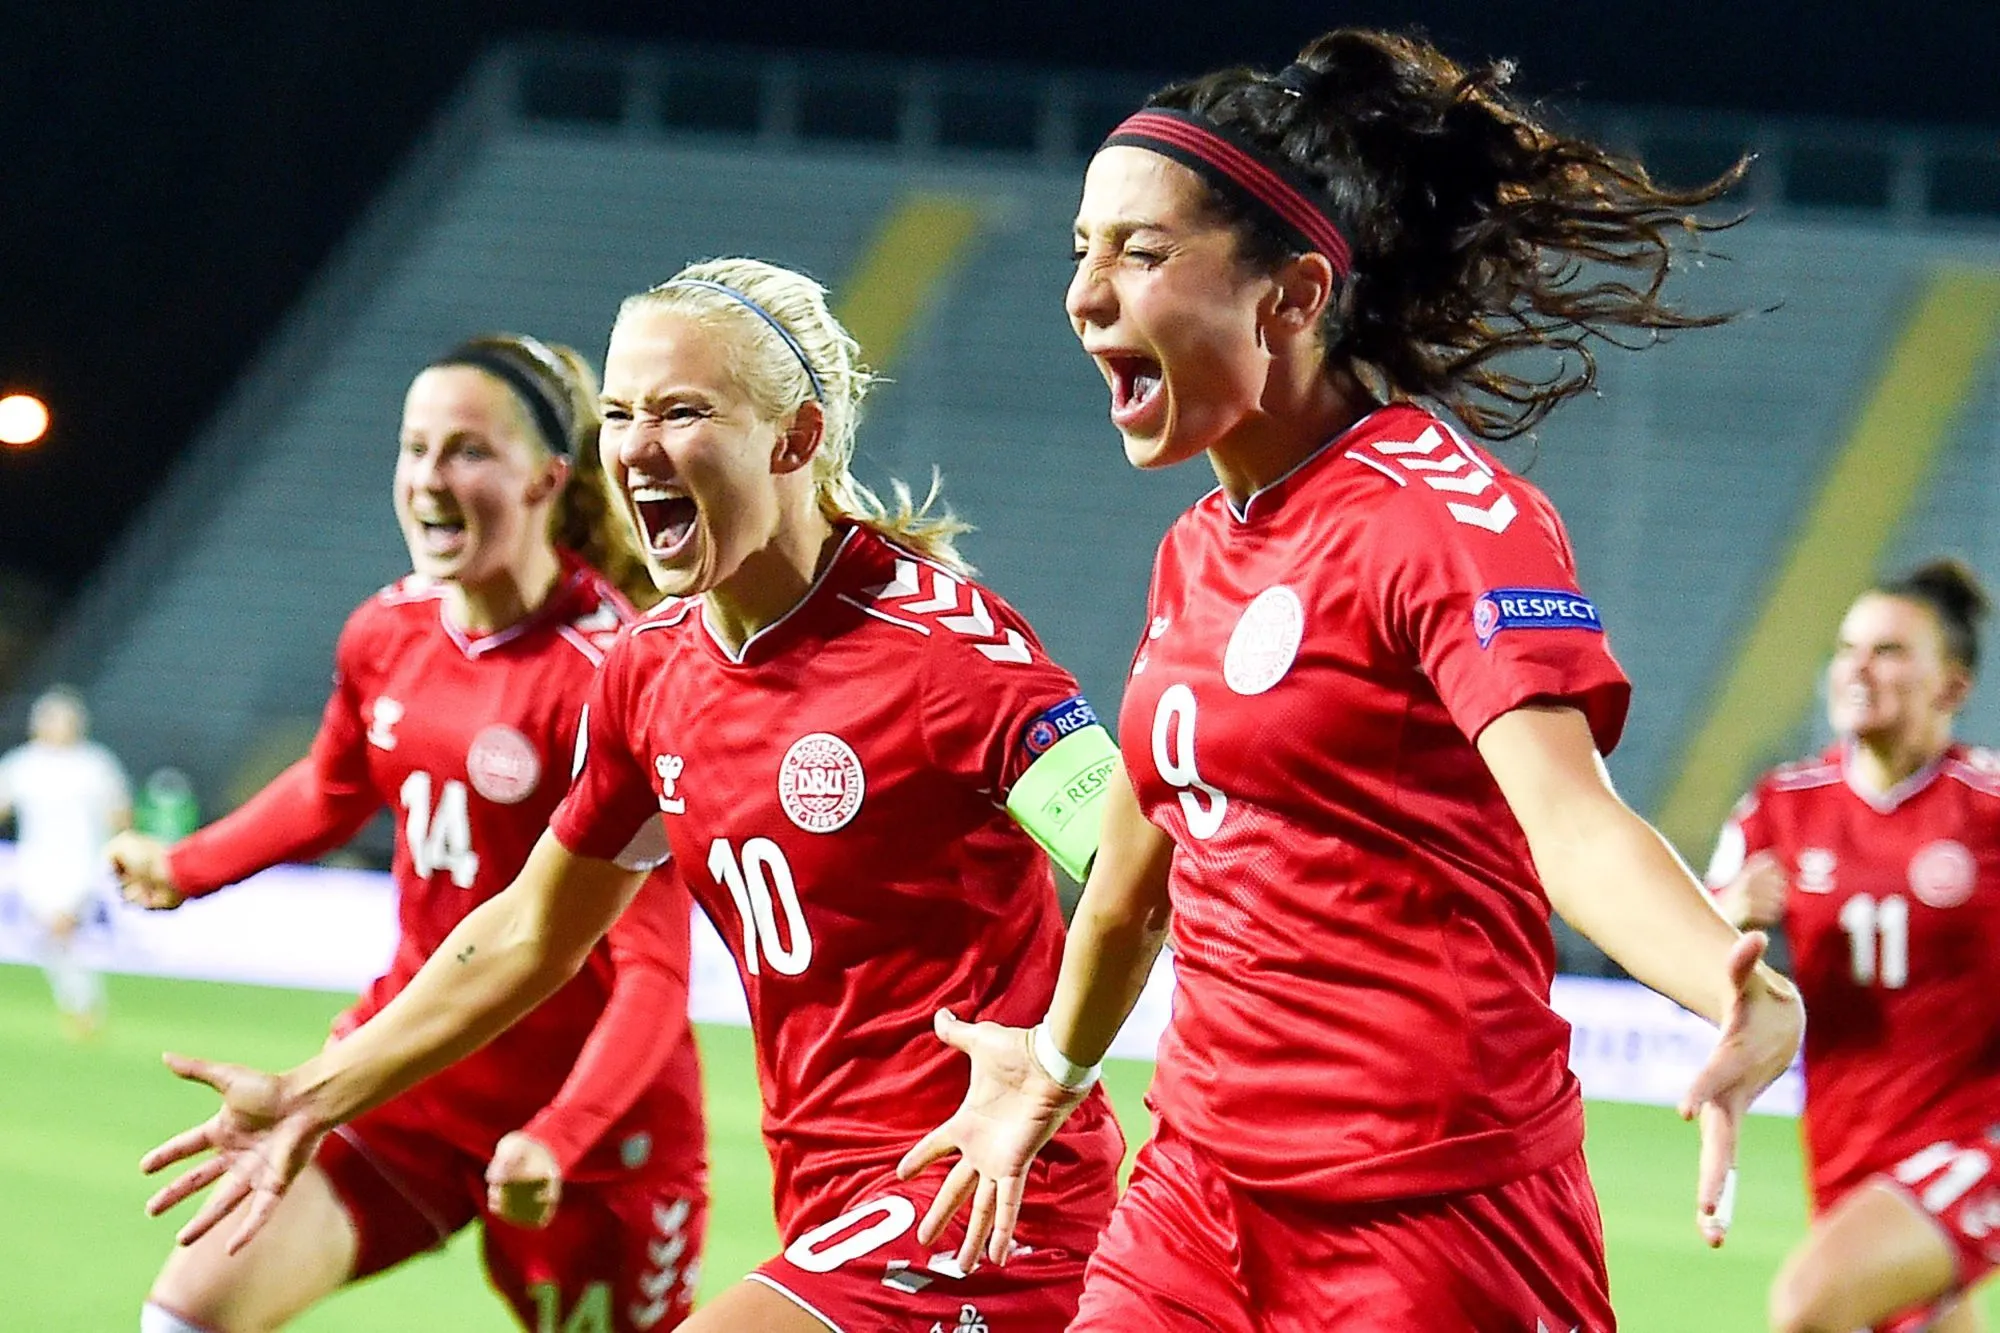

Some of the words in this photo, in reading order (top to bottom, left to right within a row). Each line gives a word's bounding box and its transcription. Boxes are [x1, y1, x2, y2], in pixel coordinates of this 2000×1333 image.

[1500, 599, 1596, 621] RESPECT
[797, 768, 844, 795] DBU
[1151, 683, 1228, 840] 9
[400, 769, 480, 890] 14
[707, 836, 813, 976] 10
[1838, 892, 1909, 989] 11
[1895, 1140, 1991, 1215] 11
[525, 1281, 615, 1333] 14
